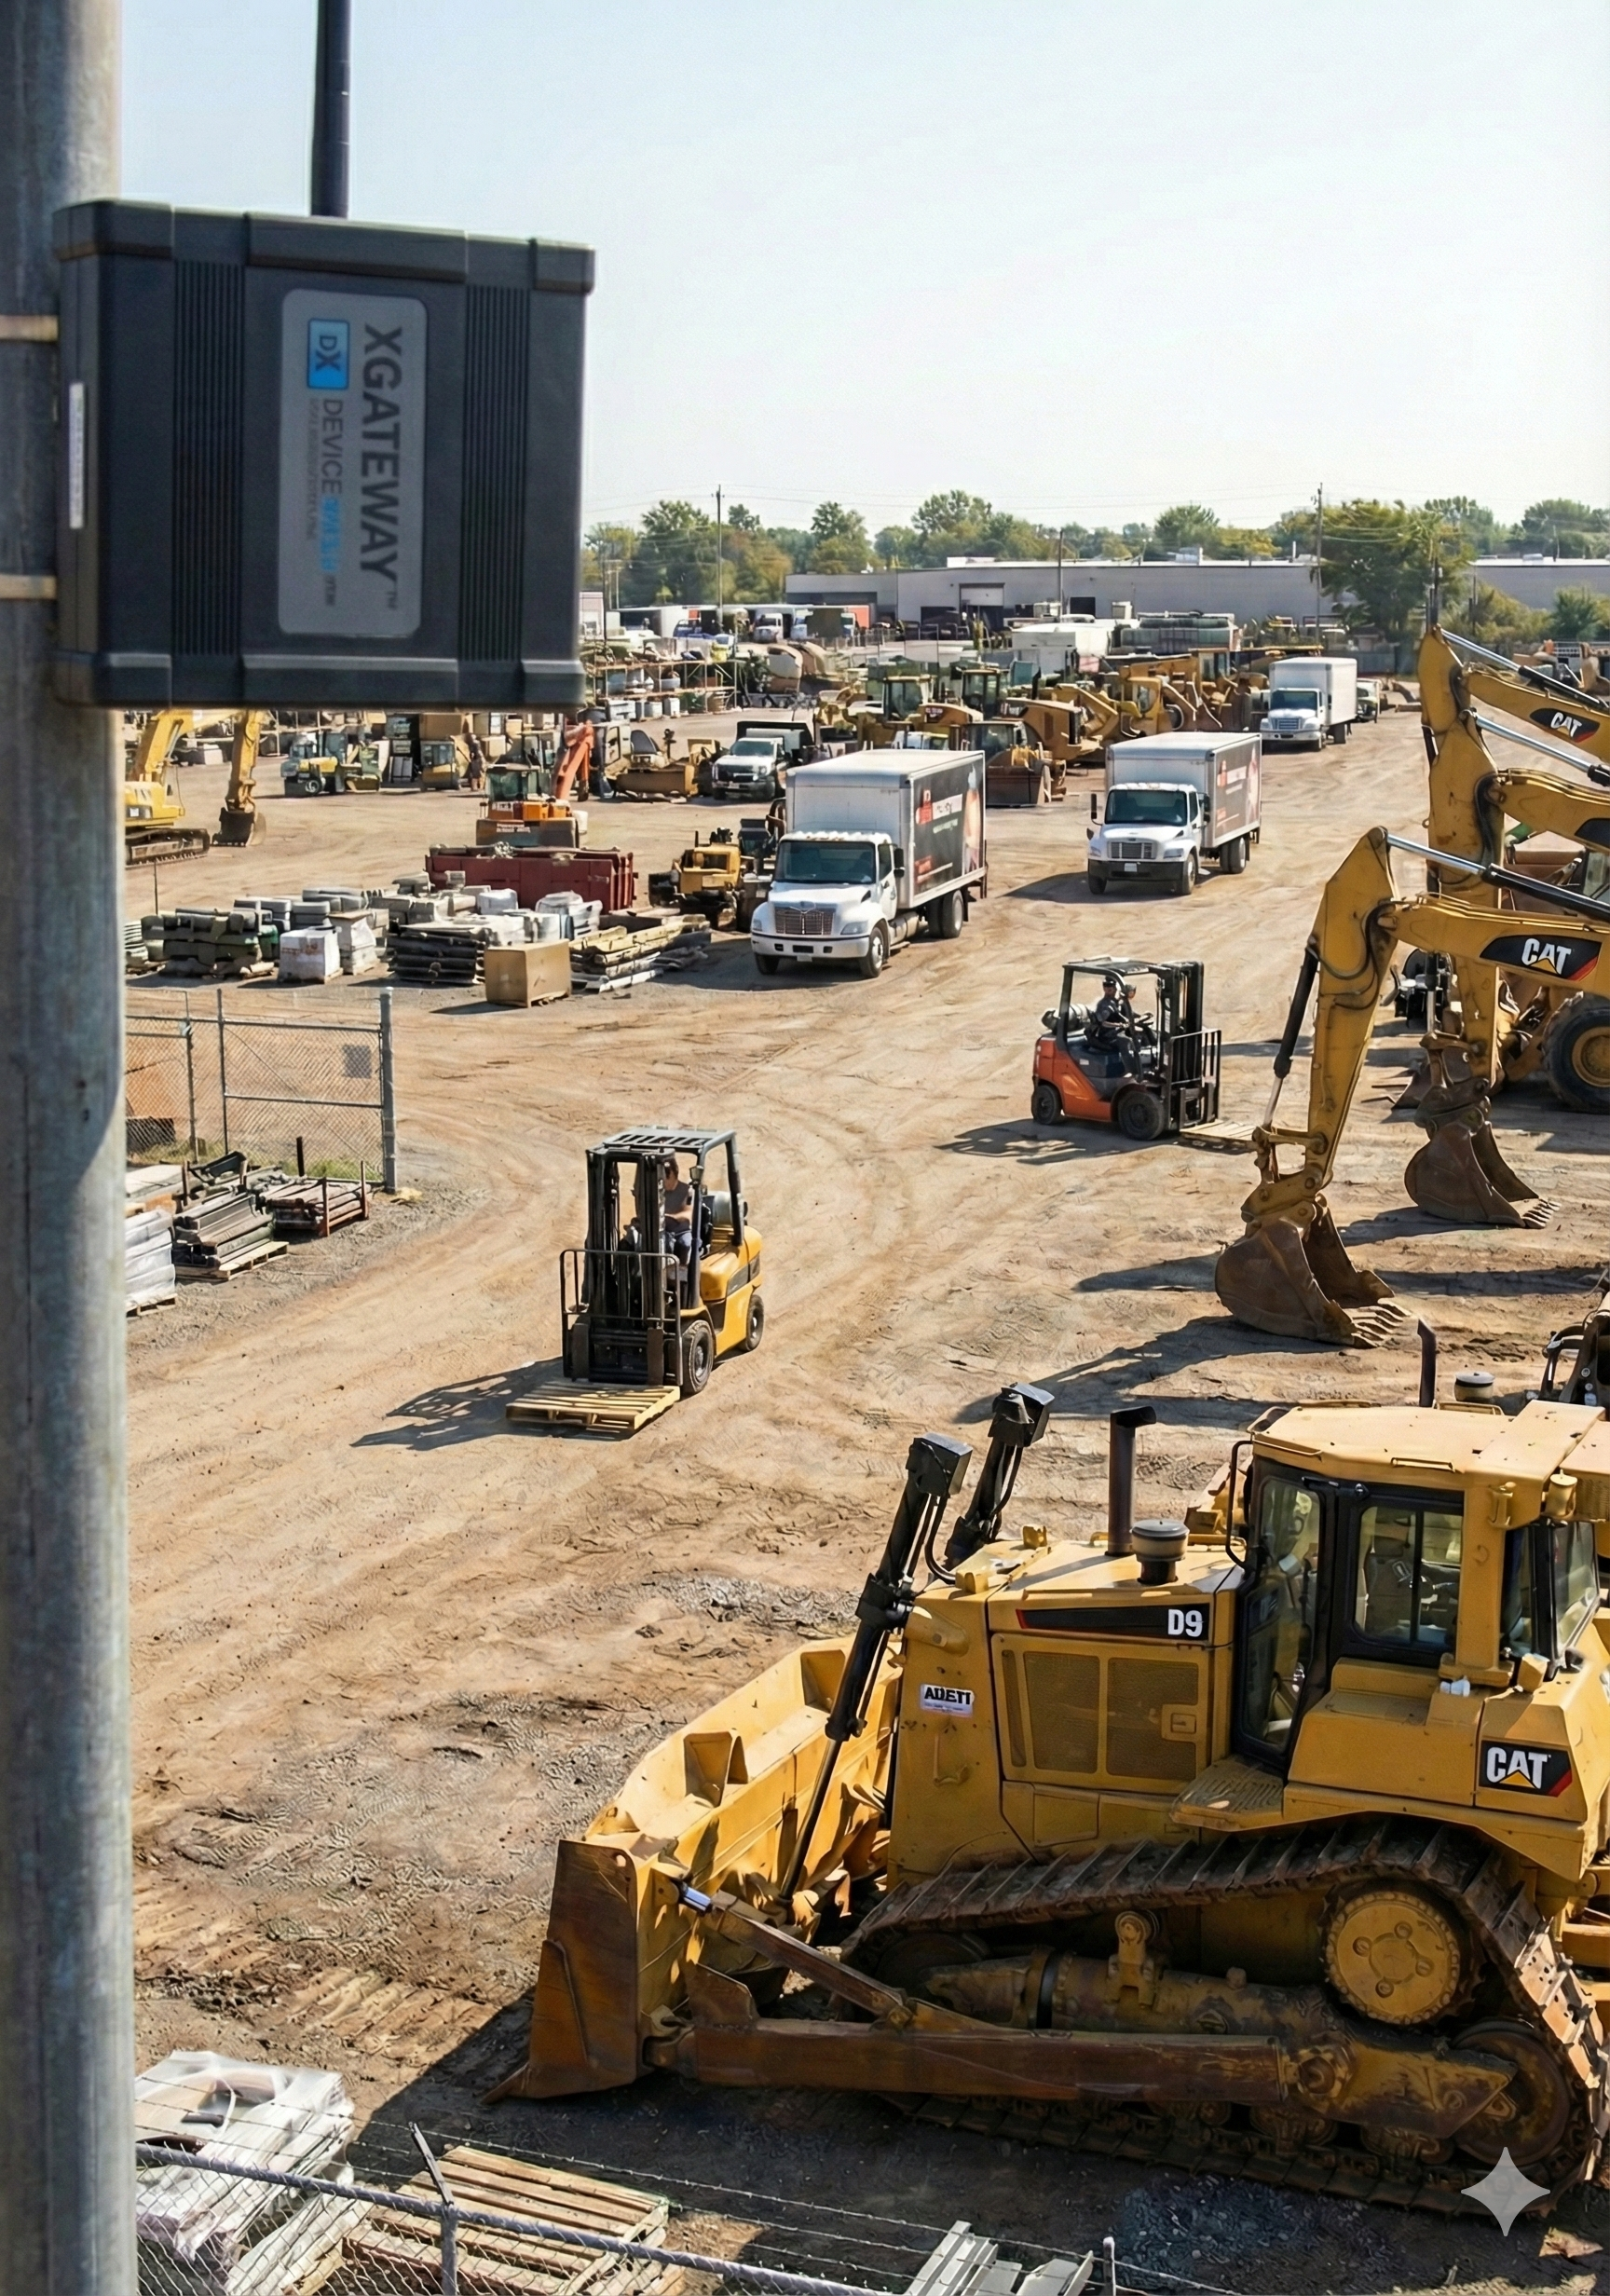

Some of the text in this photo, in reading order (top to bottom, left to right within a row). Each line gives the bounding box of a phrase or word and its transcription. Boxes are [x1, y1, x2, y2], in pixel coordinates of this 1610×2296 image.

[315, 335, 342, 372] DX
[1550, 712, 1582, 738] CAT
[1521, 937, 1572, 975] CAT
[1167, 1608, 1203, 1637] D9
[1486, 1746, 1549, 1789] CAT
